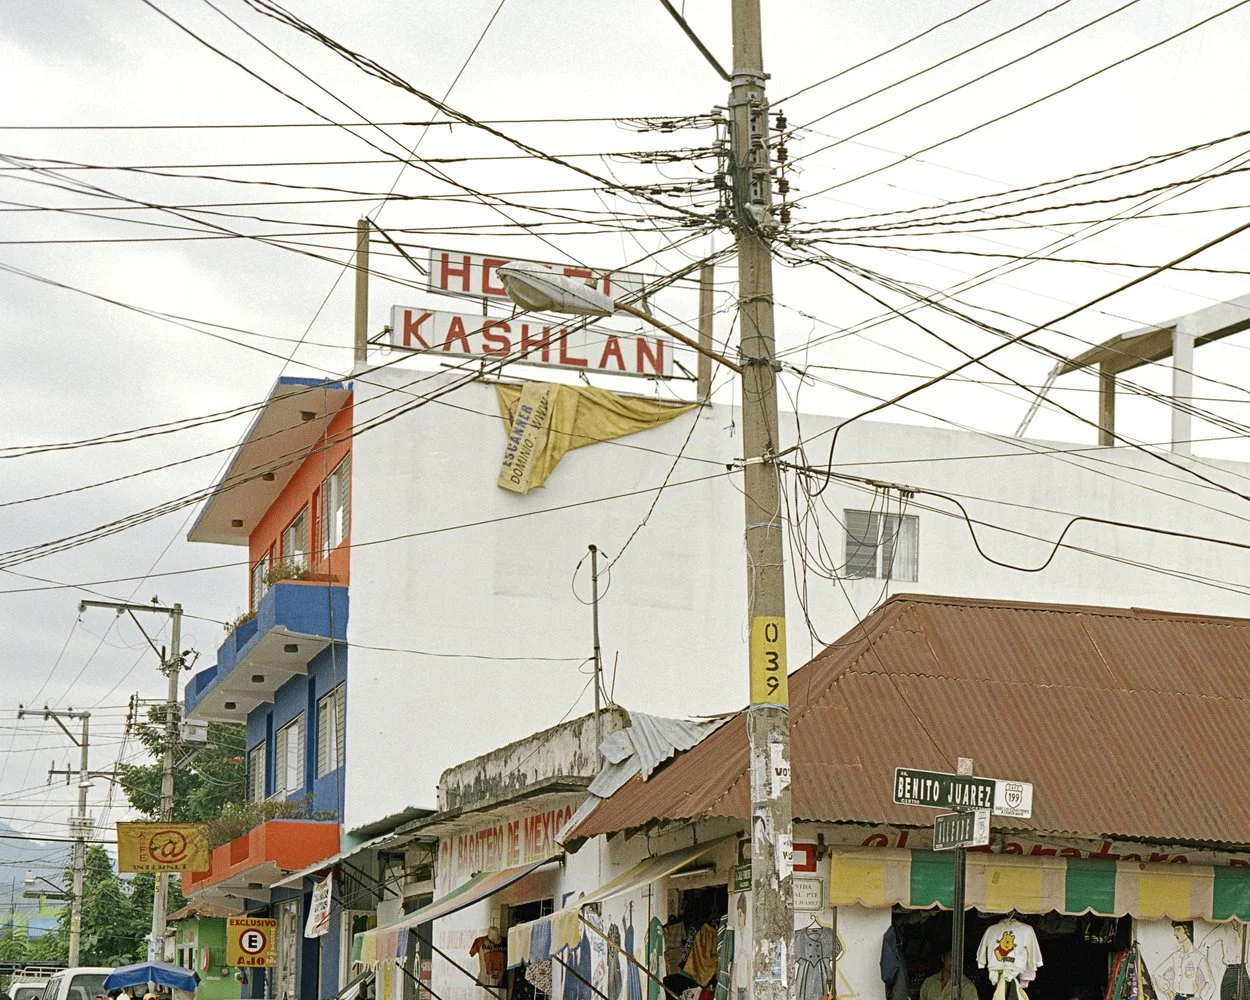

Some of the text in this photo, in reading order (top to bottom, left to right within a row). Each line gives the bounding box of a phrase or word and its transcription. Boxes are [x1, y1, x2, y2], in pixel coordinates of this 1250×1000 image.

[403, 310, 664, 375] KASHLAN
[502, 404, 533, 468] ESCANNER
[765, 623, 779, 696] 039
[898, 777, 991, 807] BENITO JUAREZ
[1009, 793, 1019, 802] 199
[507, 820, 520, 866] DE
[229, 919, 276, 927] EXCLUSIVO
[248, 935, 258, 948] E
[237, 956, 265, 966] AJO
